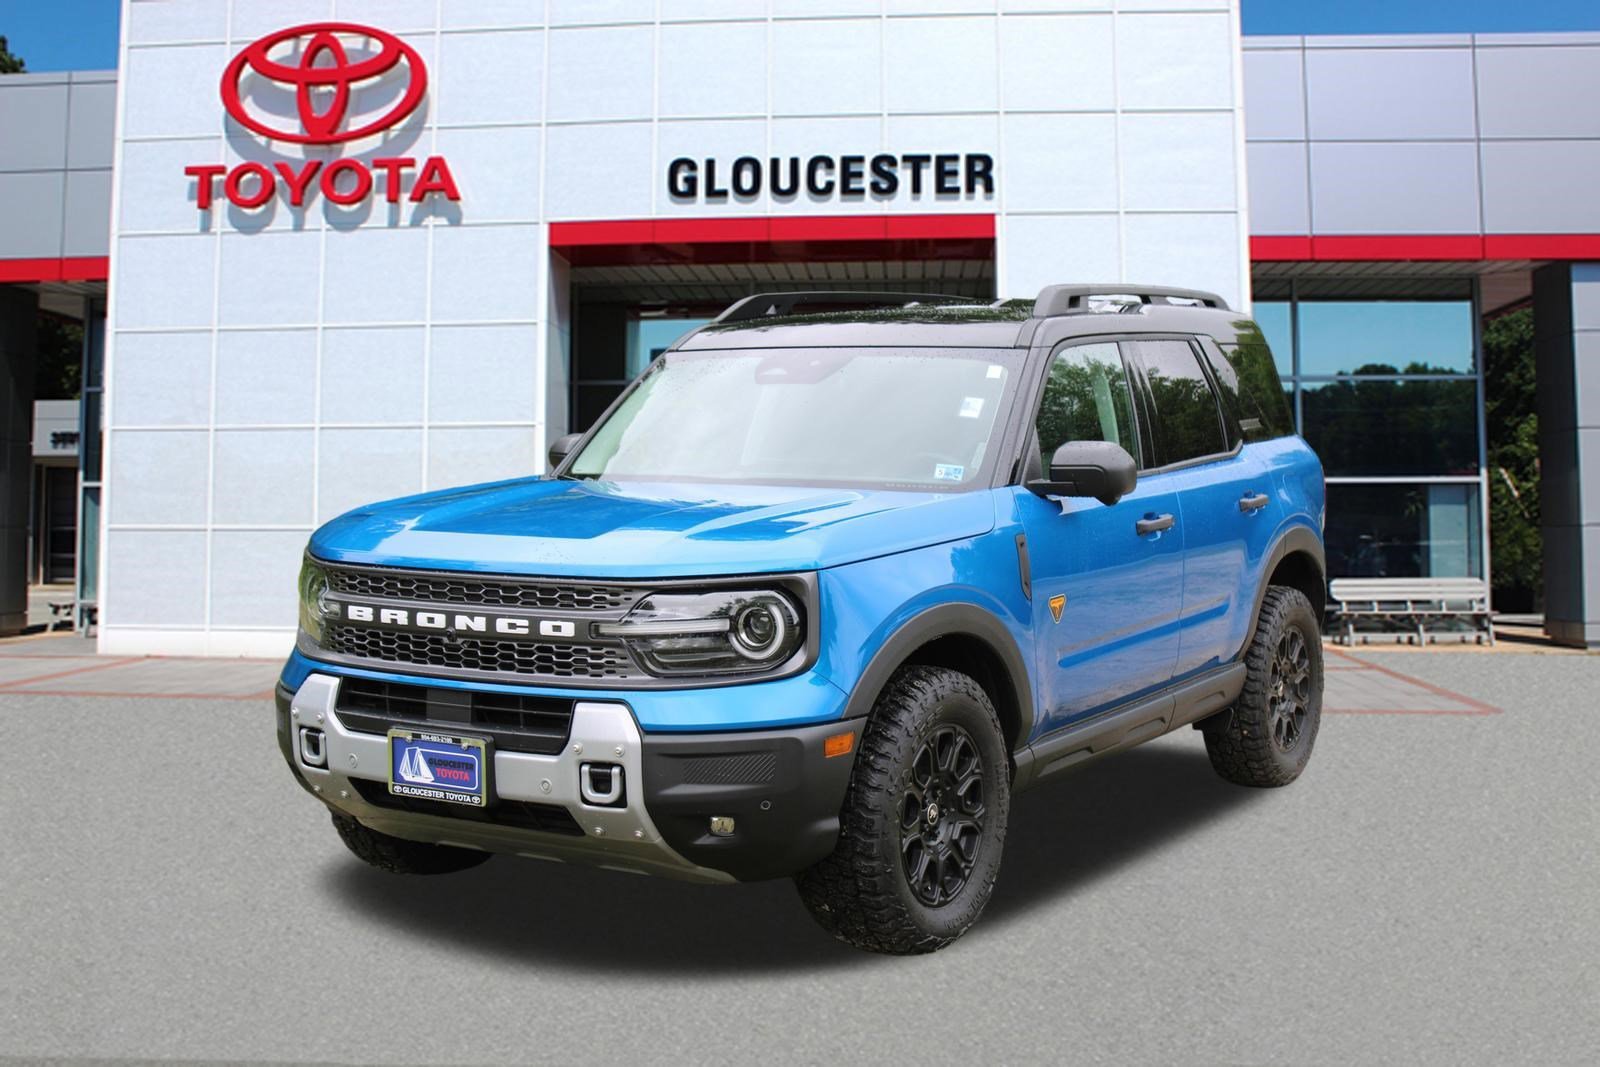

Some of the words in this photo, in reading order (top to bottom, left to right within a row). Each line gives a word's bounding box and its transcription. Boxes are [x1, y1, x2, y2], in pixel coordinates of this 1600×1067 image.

[184, 156, 461, 210] TOYOTA
[667, 153, 995, 198] GLOUCESTER
[347, 605, 576, 637] BRONCO
[429, 757, 474, 770] GLOUCESTER
[436, 768, 469, 781] TOYOTA
[402, 786, 445, 799] GLOUCESTER
[446, 792, 472, 803] TOYOTA
